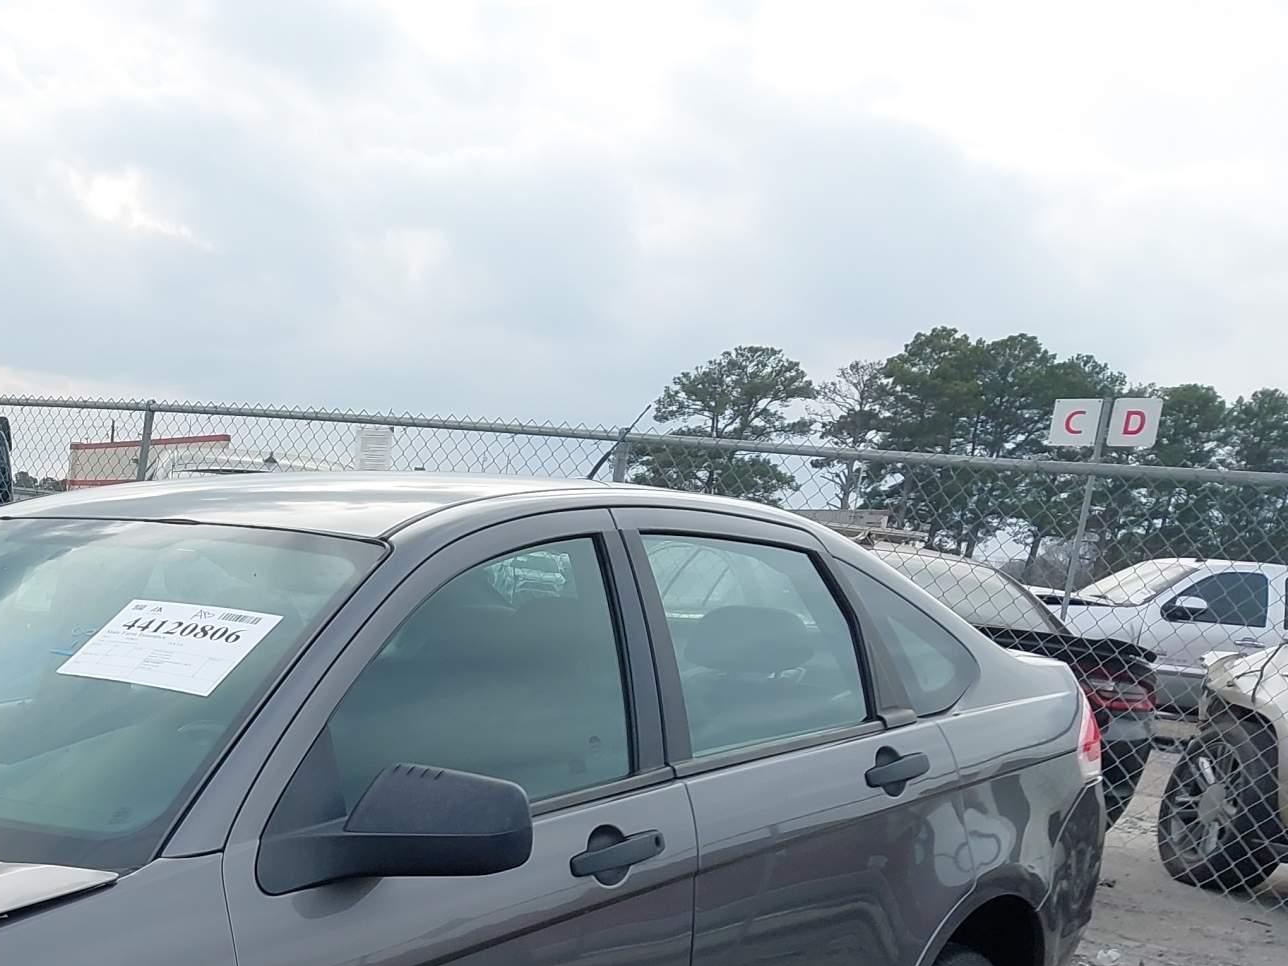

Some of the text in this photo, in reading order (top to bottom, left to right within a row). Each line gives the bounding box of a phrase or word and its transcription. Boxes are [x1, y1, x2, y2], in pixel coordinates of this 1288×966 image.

[1064, 409, 1087, 434] C
[1122, 409, 1146, 435] D
[122, 616, 247, 643] 44120806
